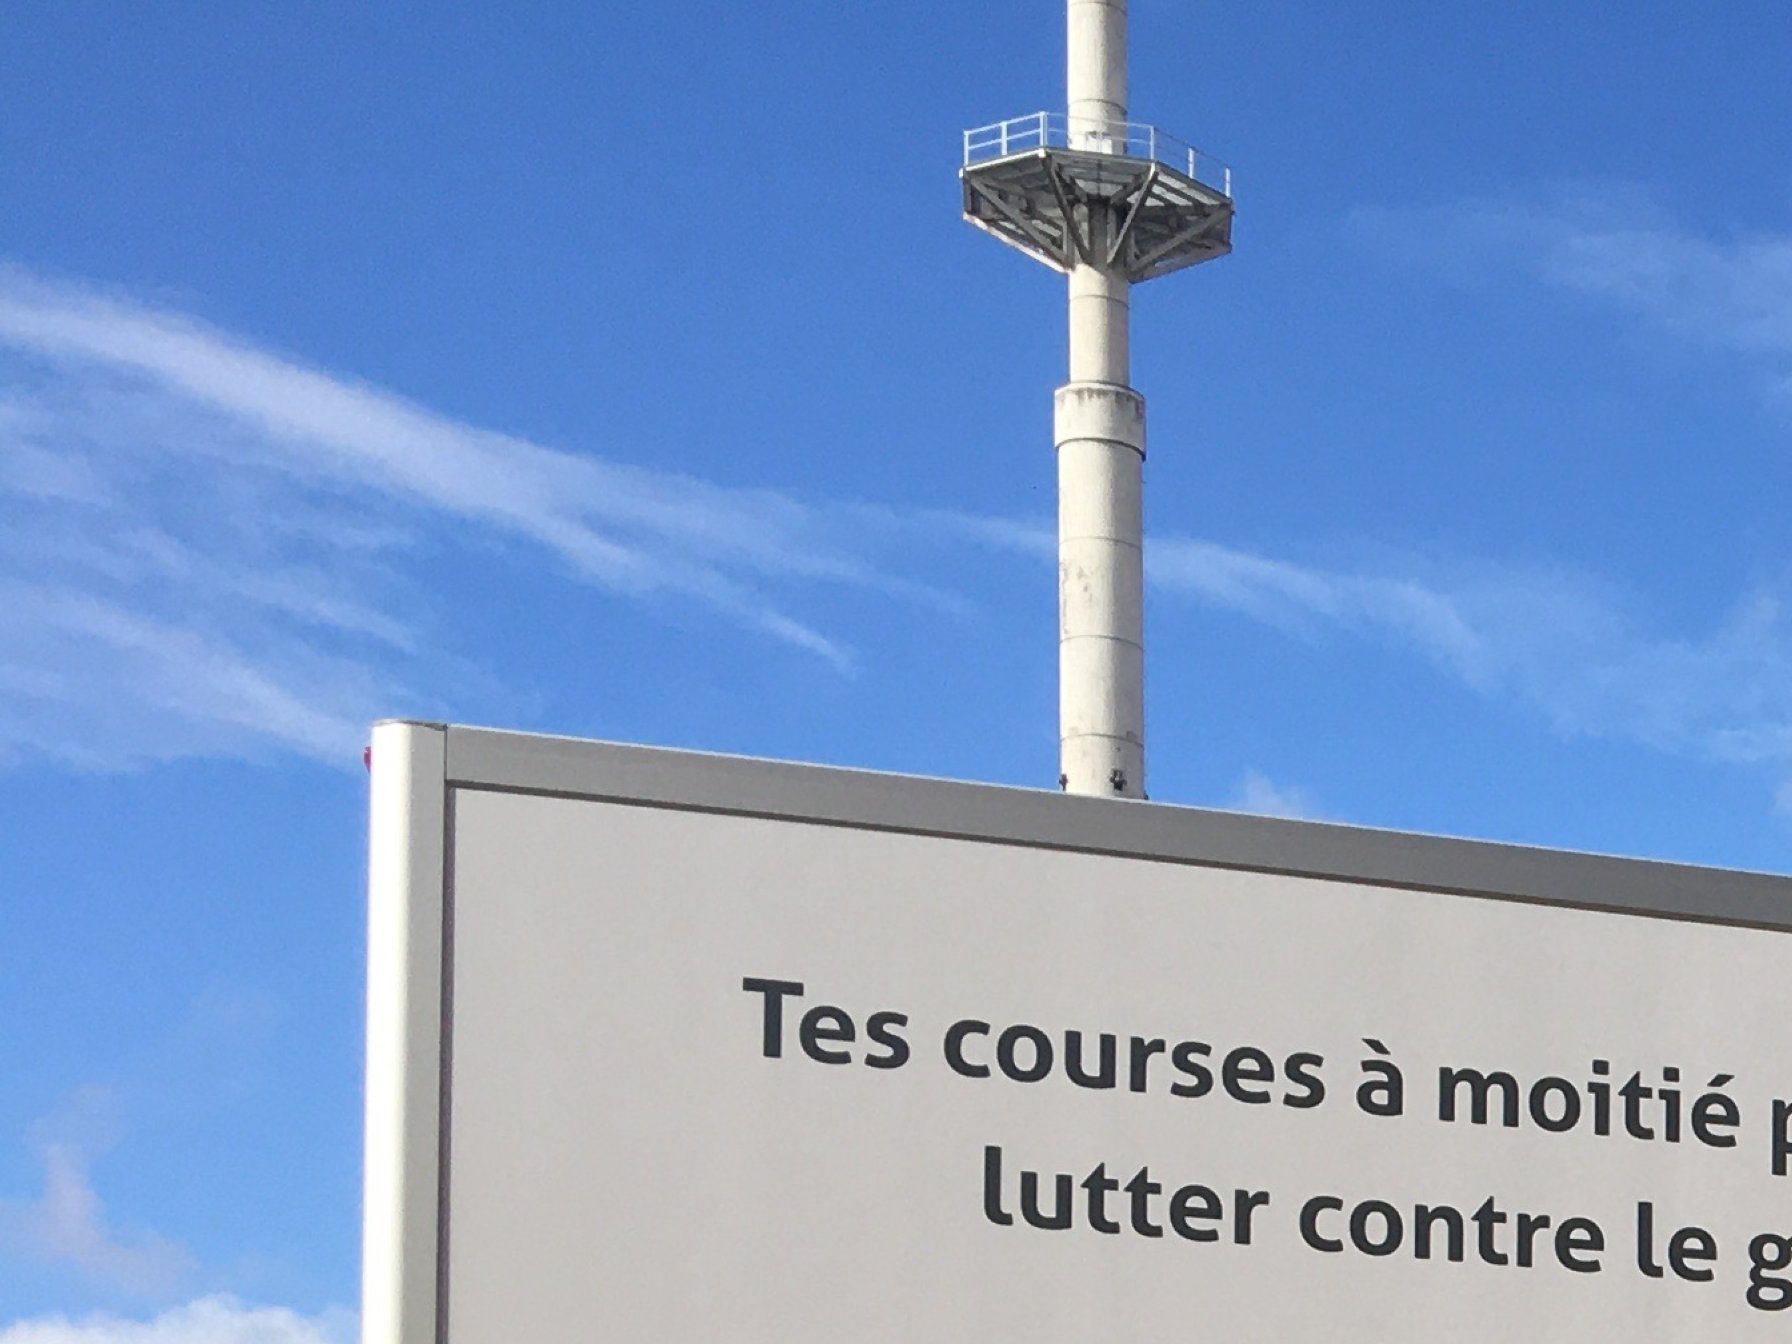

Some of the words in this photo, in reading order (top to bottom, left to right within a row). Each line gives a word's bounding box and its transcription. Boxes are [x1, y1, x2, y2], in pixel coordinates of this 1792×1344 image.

[742, 977, 911, 1070] Tes
[943, 1019, 1326, 1109] courses
[1355, 1038, 1404, 1117] à
[1438, 1059, 1740, 1148] moitié
[983, 1145, 1270, 1246] lutter
[1299, 1195, 1605, 1273] contre
[1637, 1201, 1718, 1283] le
